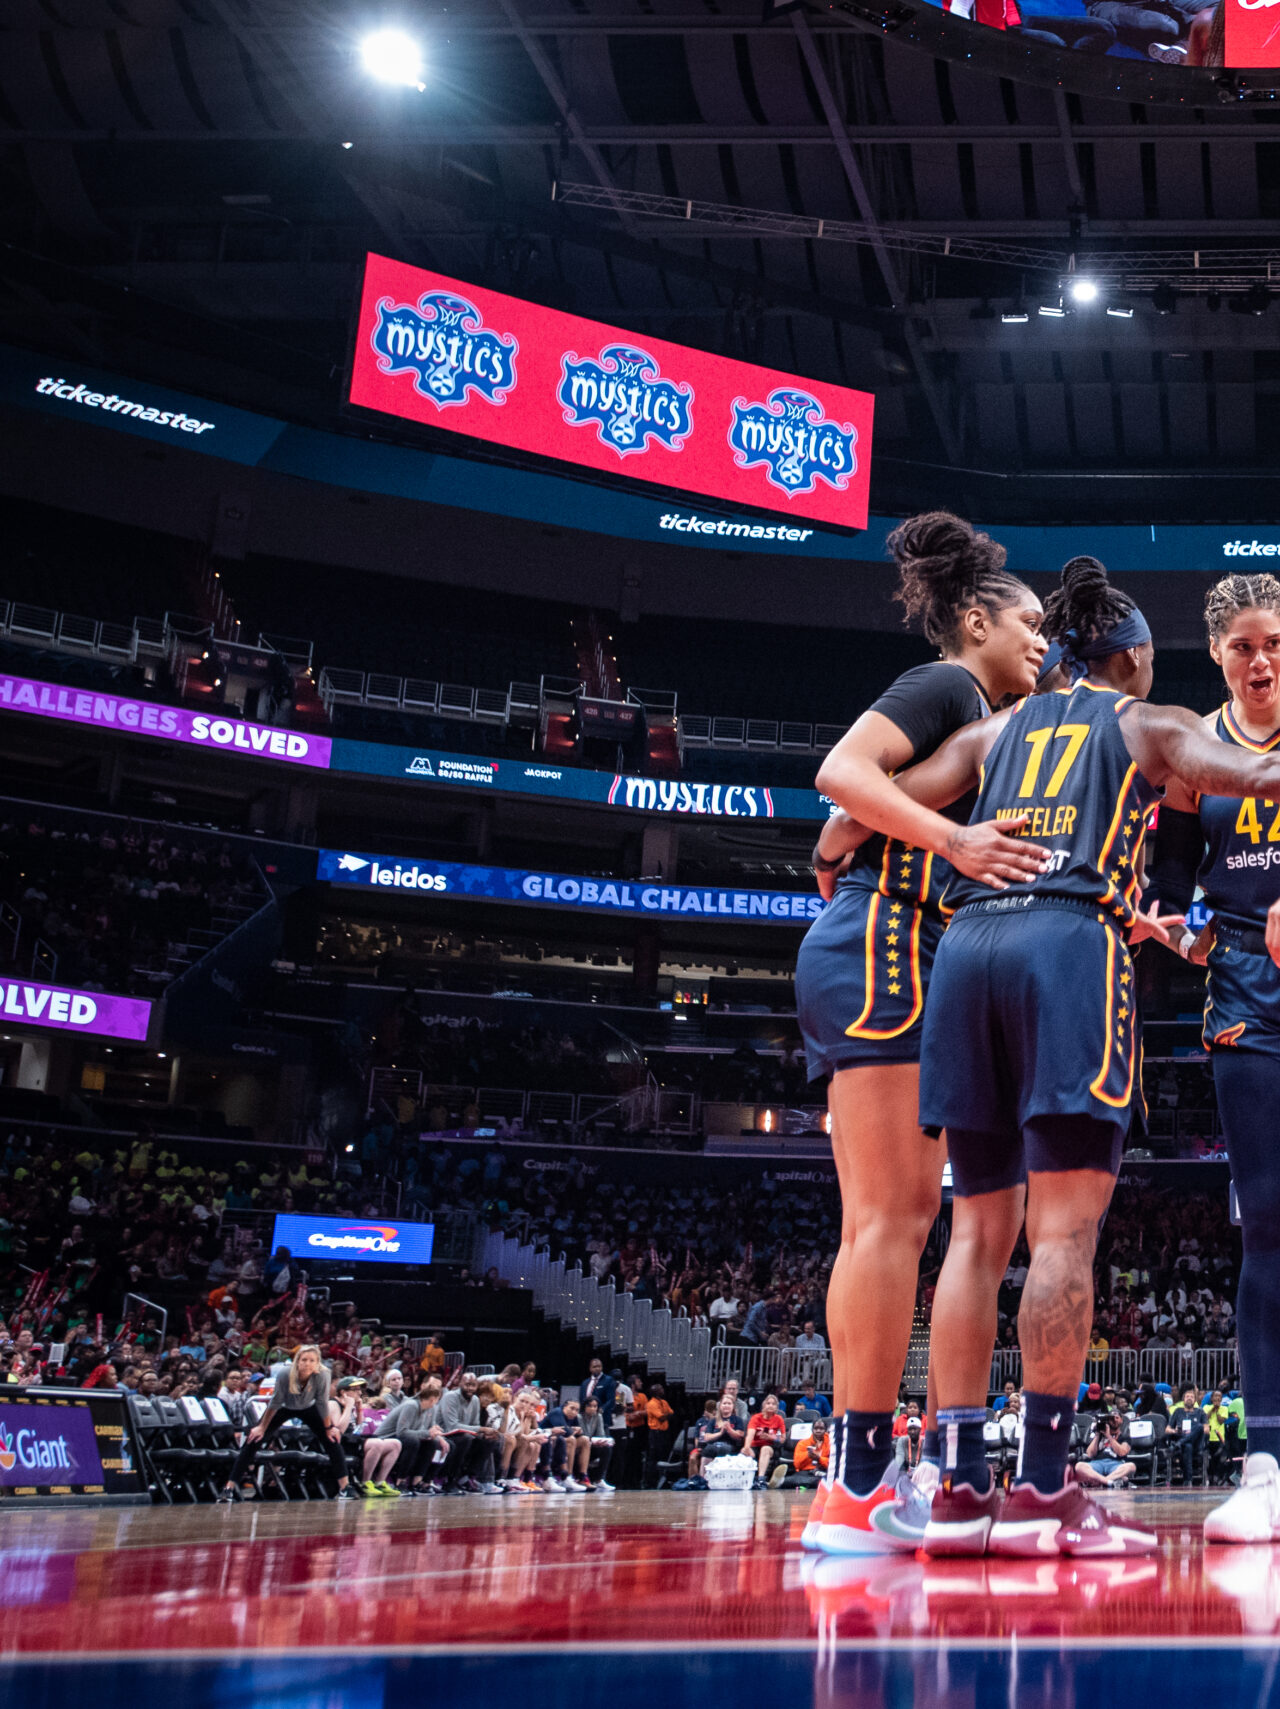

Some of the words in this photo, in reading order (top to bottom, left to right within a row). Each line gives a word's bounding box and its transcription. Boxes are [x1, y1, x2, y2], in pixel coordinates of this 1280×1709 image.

[36, 377, 215, 434] ticketmaster
[659, 513, 813, 543] ticketmaster
[191, 716, 309, 758] SOLVED
[439, 760, 494, 774] FOUNDATION
[464, 772, 493, 783] RAFFLE
[523, 767, 562, 780] JACKPOT
[1018, 724, 1090, 798] 17
[370, 862, 447, 891] leidos
[522, 874, 635, 908] GLOBAL
[17, 1428, 70, 1469] Giant
